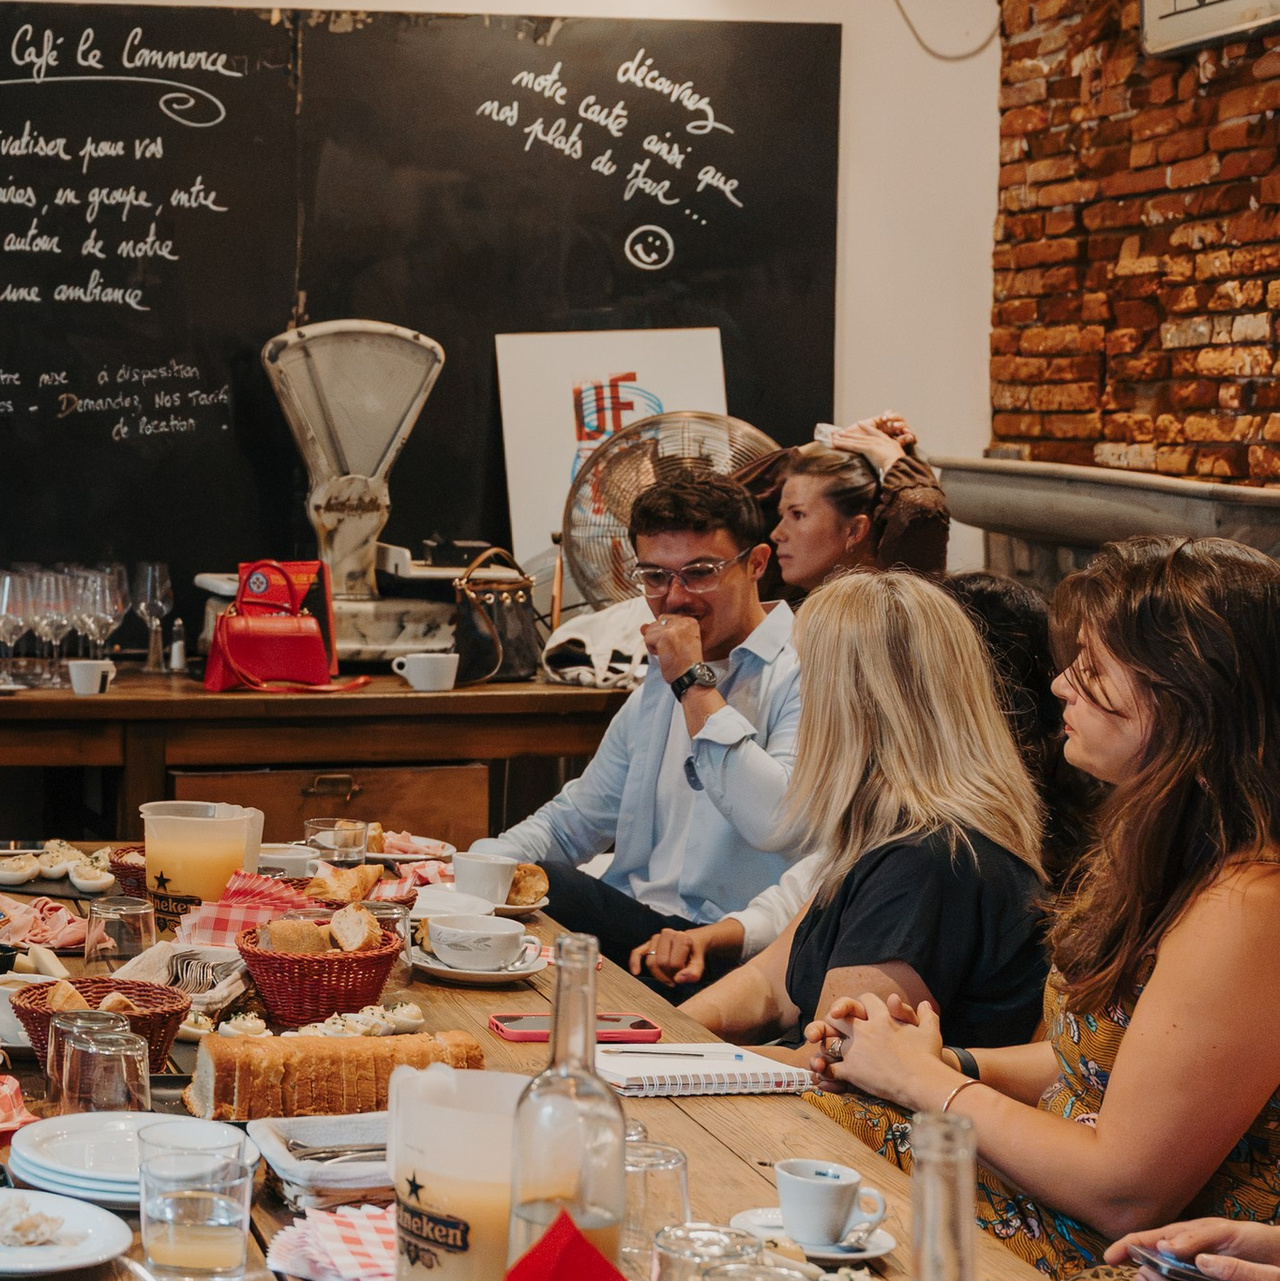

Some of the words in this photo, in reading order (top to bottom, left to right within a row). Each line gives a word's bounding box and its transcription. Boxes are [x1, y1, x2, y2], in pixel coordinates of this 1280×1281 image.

[11, 25, 64, 83] Café
[123, 28, 242, 77] Commerce
[477, 101, 518, 126] nos
[524, 117, 582, 159] plats
[591, 150, 616, 175] du
[512, 61, 567, 106] notre
[643, 131, 692, 169] ainsi
[697, 166, 742, 206] que
[79, 137, 124, 173] pour
[135, 137, 163, 159] vos
[55, 189, 80, 205] en
[171, 176, 227, 211] entre
[4, 218, 61, 252] autour
[82, 230, 105, 258] de
[118, 218, 178, 260] notre
[0, 285, 41, 301] une
[54, 270, 149, 310] ambiance
